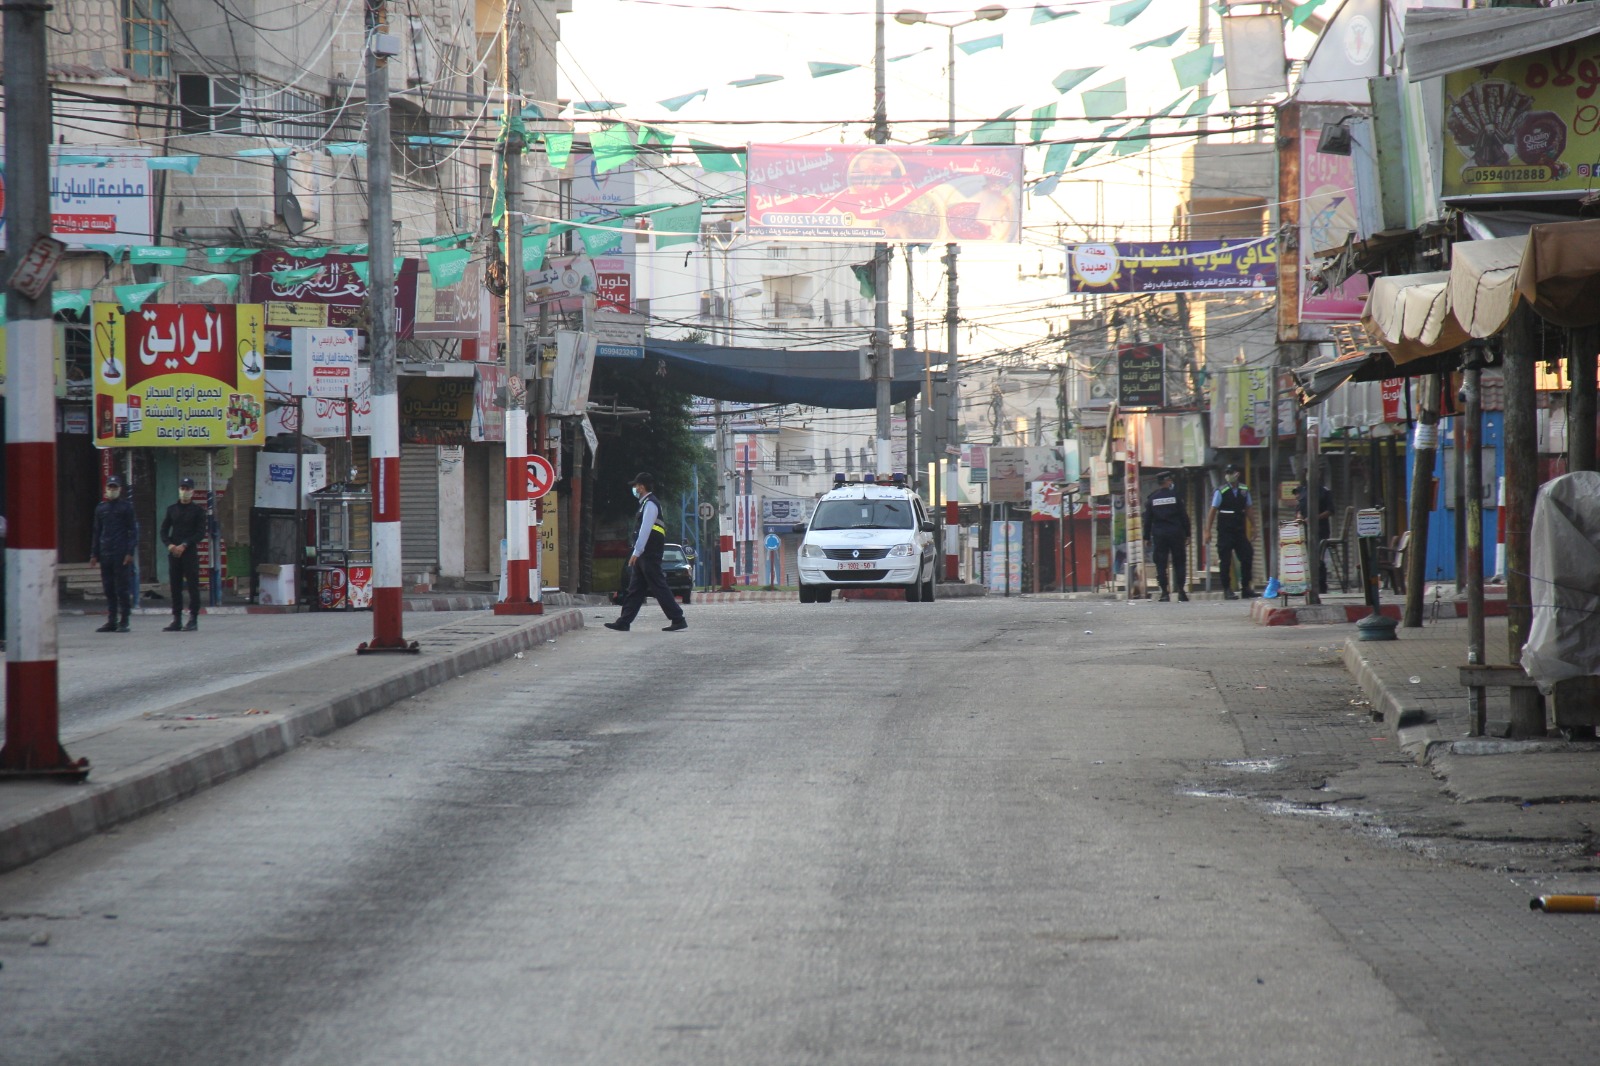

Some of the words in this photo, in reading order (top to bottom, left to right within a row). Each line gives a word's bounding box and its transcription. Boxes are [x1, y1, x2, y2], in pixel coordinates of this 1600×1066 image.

[1523, 132, 1551, 144] Quality
[1526, 141, 1548, 151] Street
[1475, 168, 1545, 181] 0594012888
[62, 178, 96, 204] البيان
[98, 178, 144, 204] مطبعة
[602, 193, 621, 201] عيادة
[91, 217, 112, 229] لمسة
[1123, 243, 1188, 274] الشباب
[1193, 241, 1232, 271] شوب
[1237, 242, 1276, 275] كافي
[1080, 262, 1111, 274] الجديدة
[530, 270, 559, 286] شرك
[598, 276, 628, 291] حلويا
[1156, 280, 1173, 289] شباب
[1192, 278, 1217, 288] الشرقي
[1143, 282, 1156, 290] رفح
[139, 310, 223, 369] الرايق
[337, 353, 353, 364] مطبعة
[600, 347, 638, 357] 0599423243
[1122, 360, 1160, 369] حلويات
[145, 386, 174, 401] السجائر
[175, 385, 195, 402] أنواع
[197, 386, 222, 402] لجميع
[1122, 384, 1160, 395] الفاخرة
[145, 405, 183, 420] والشيشة
[185, 407, 223, 420] والمعسل
[404, 397, 458, 417] يونيون
[156, 424, 185, 441] أنواعها
[187, 426, 210, 441] بكافة
